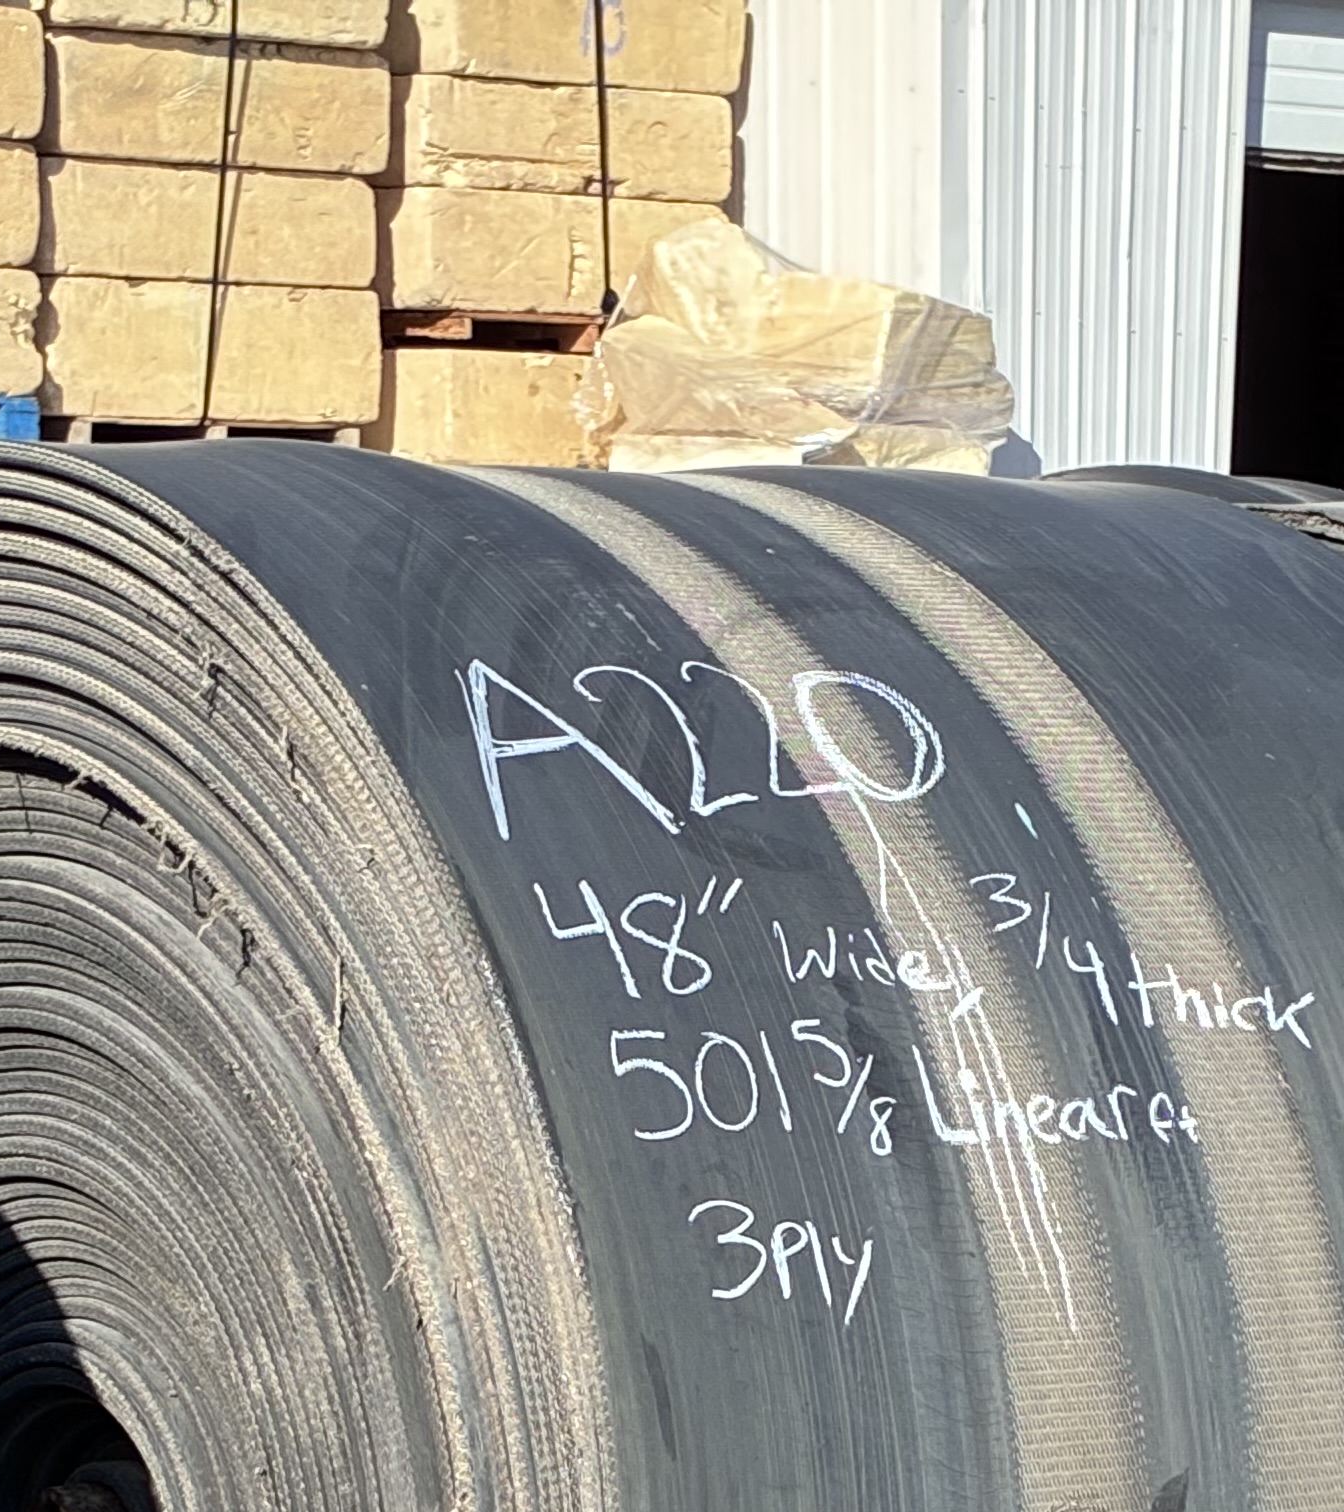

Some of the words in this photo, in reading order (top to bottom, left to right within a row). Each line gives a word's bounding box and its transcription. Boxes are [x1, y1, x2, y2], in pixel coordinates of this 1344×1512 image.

[456, 657, 946, 842] A220
[534, 876, 744, 998] 48"
[968, 872, 1120, 1027] 3/4
[1127, 950, 1316, 1050] thick
